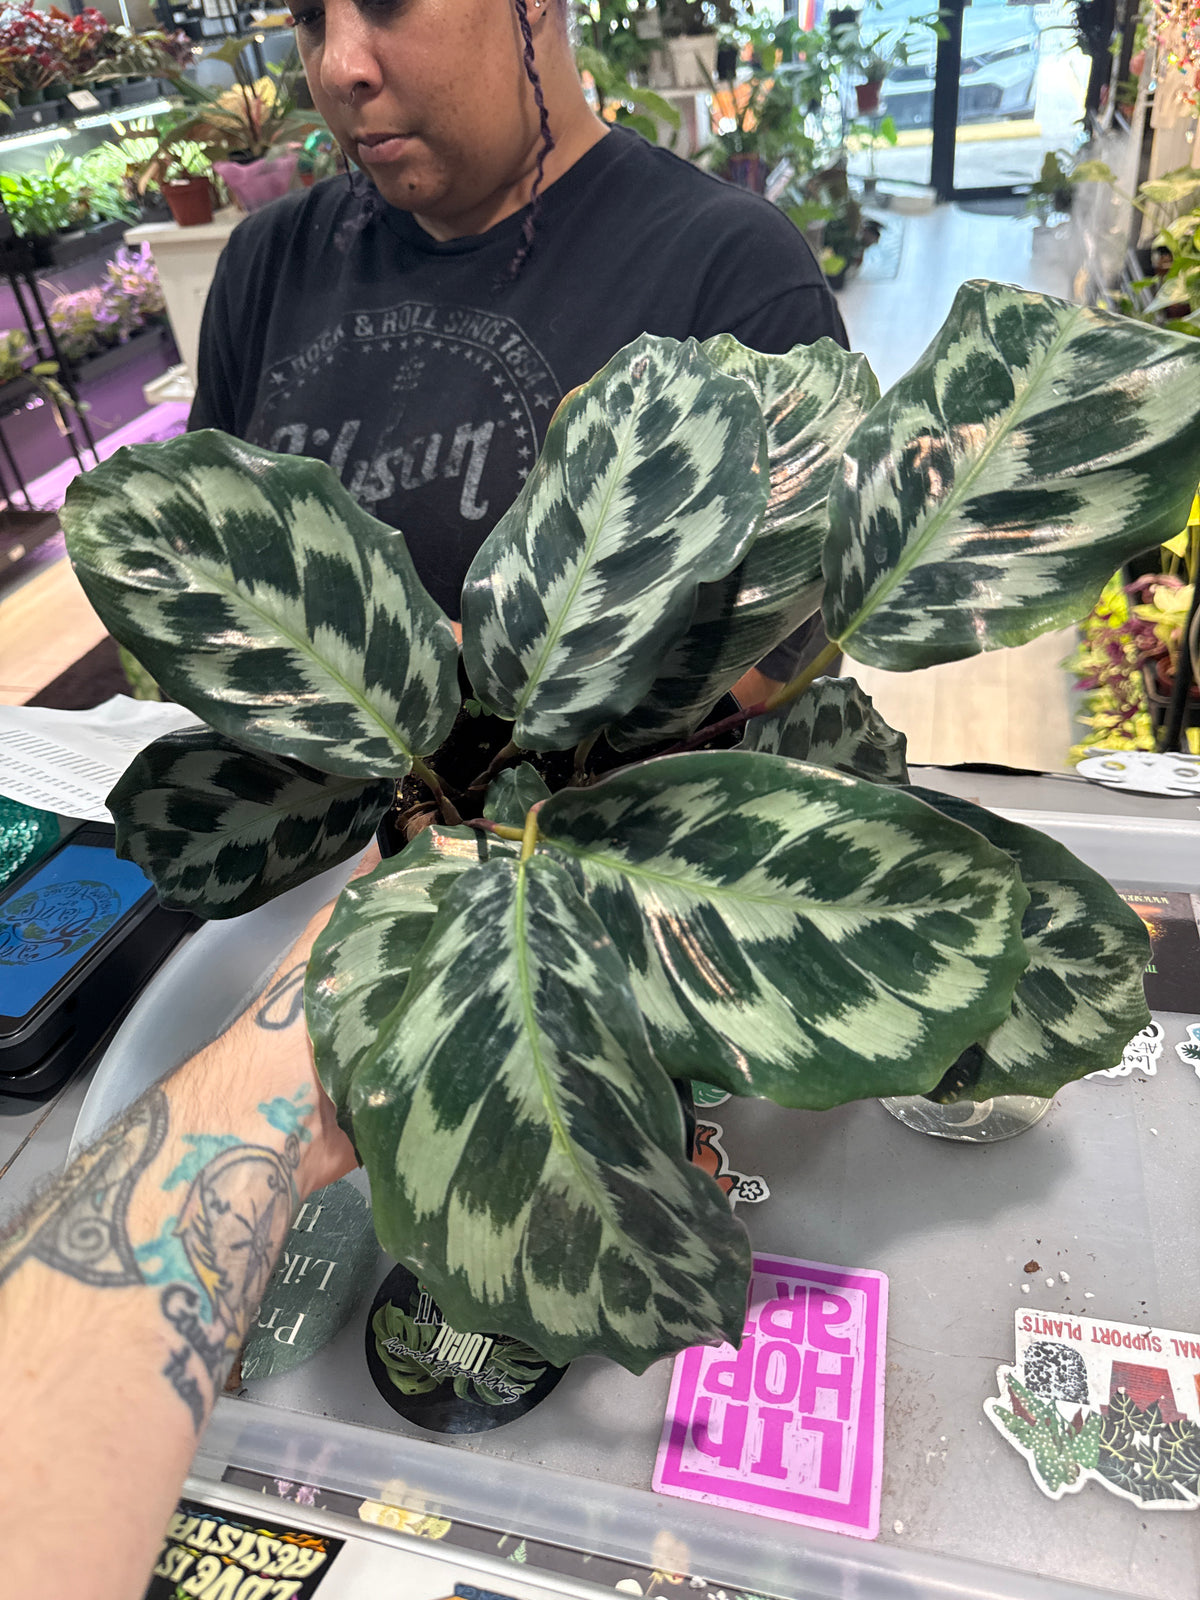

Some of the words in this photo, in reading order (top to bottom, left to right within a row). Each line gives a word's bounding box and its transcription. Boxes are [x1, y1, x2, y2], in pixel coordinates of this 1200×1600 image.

[354, 314, 374, 337] &
[381, 306, 438, 334] ROLL
[443, 310, 507, 345] SINCE
[277, 1250, 338, 1290] Lik
[1022, 1315, 1081, 1341] PLANTS
[1091, 1327, 1162, 1354] SUPPORT
[381, 1337, 439, 1370] your
[423, 1324, 494, 1374] LOCAL
[1170, 1339, 1200, 1359] NAL
[433, 1360, 526, 1404] Support
[702, 1335, 855, 1421] HOP
[167, 1514, 327, 1577] RESISTA
